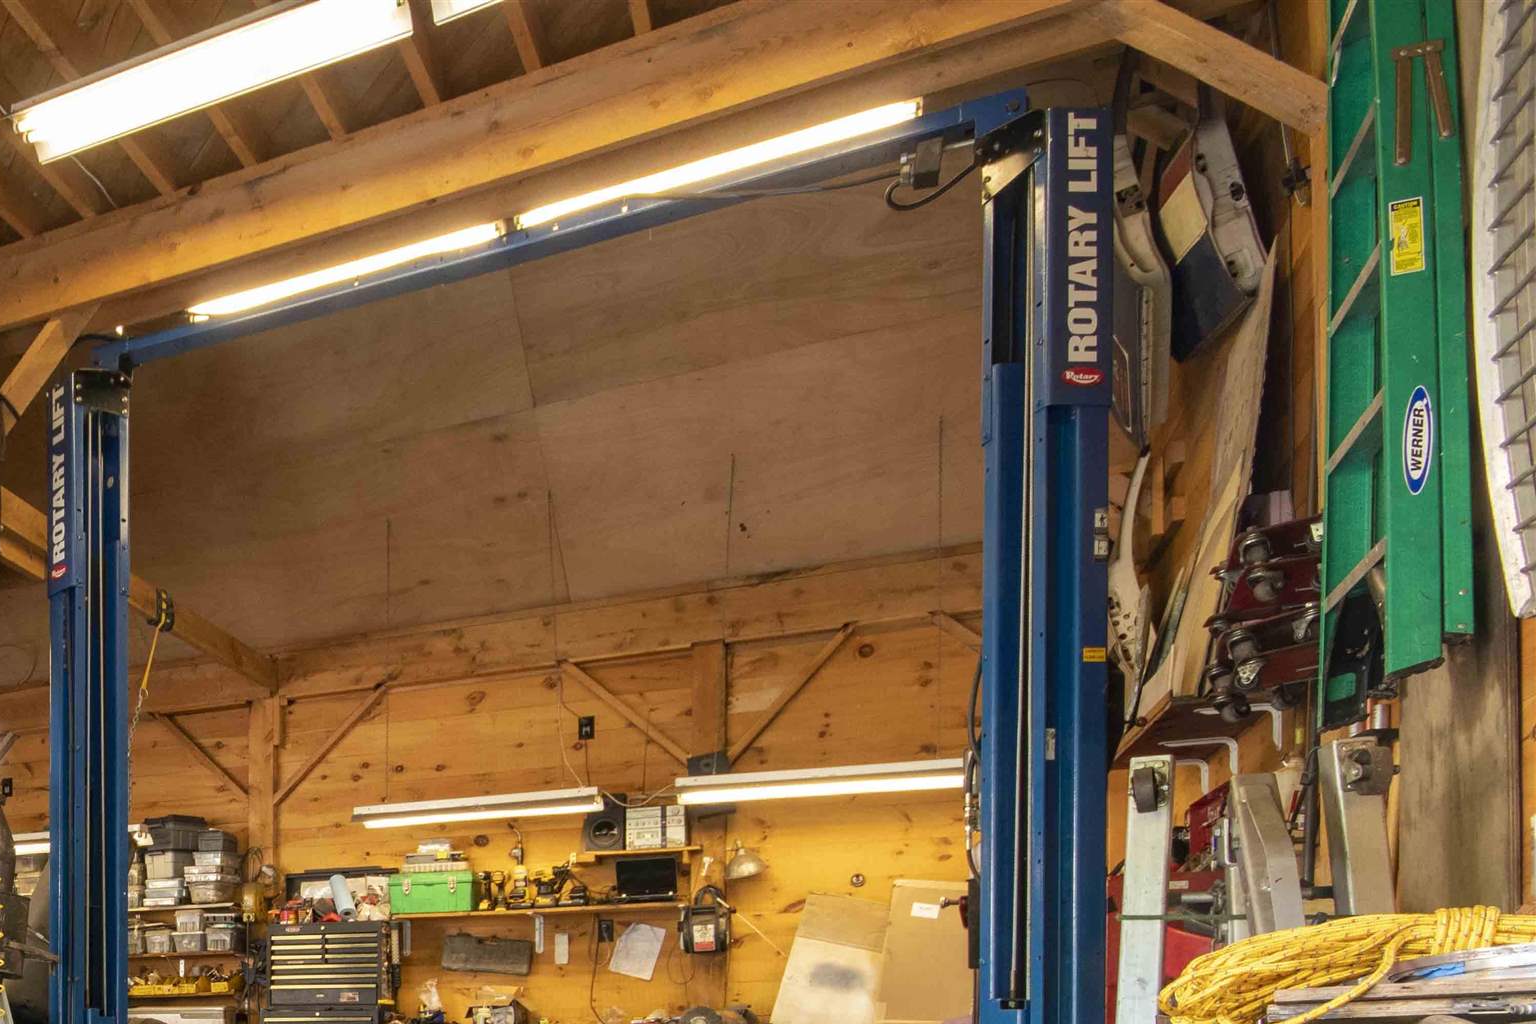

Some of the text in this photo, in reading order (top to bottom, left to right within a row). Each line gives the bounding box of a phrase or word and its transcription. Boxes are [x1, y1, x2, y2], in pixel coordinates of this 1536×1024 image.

[1067, 112, 1098, 362] ROTARY LIFT
[1064, 369, 1101, 384] Rotary
[52, 385, 65, 446] LIFT
[1410, 407, 1425, 471] WERNER
[52, 452, 66, 564] ROTARY
